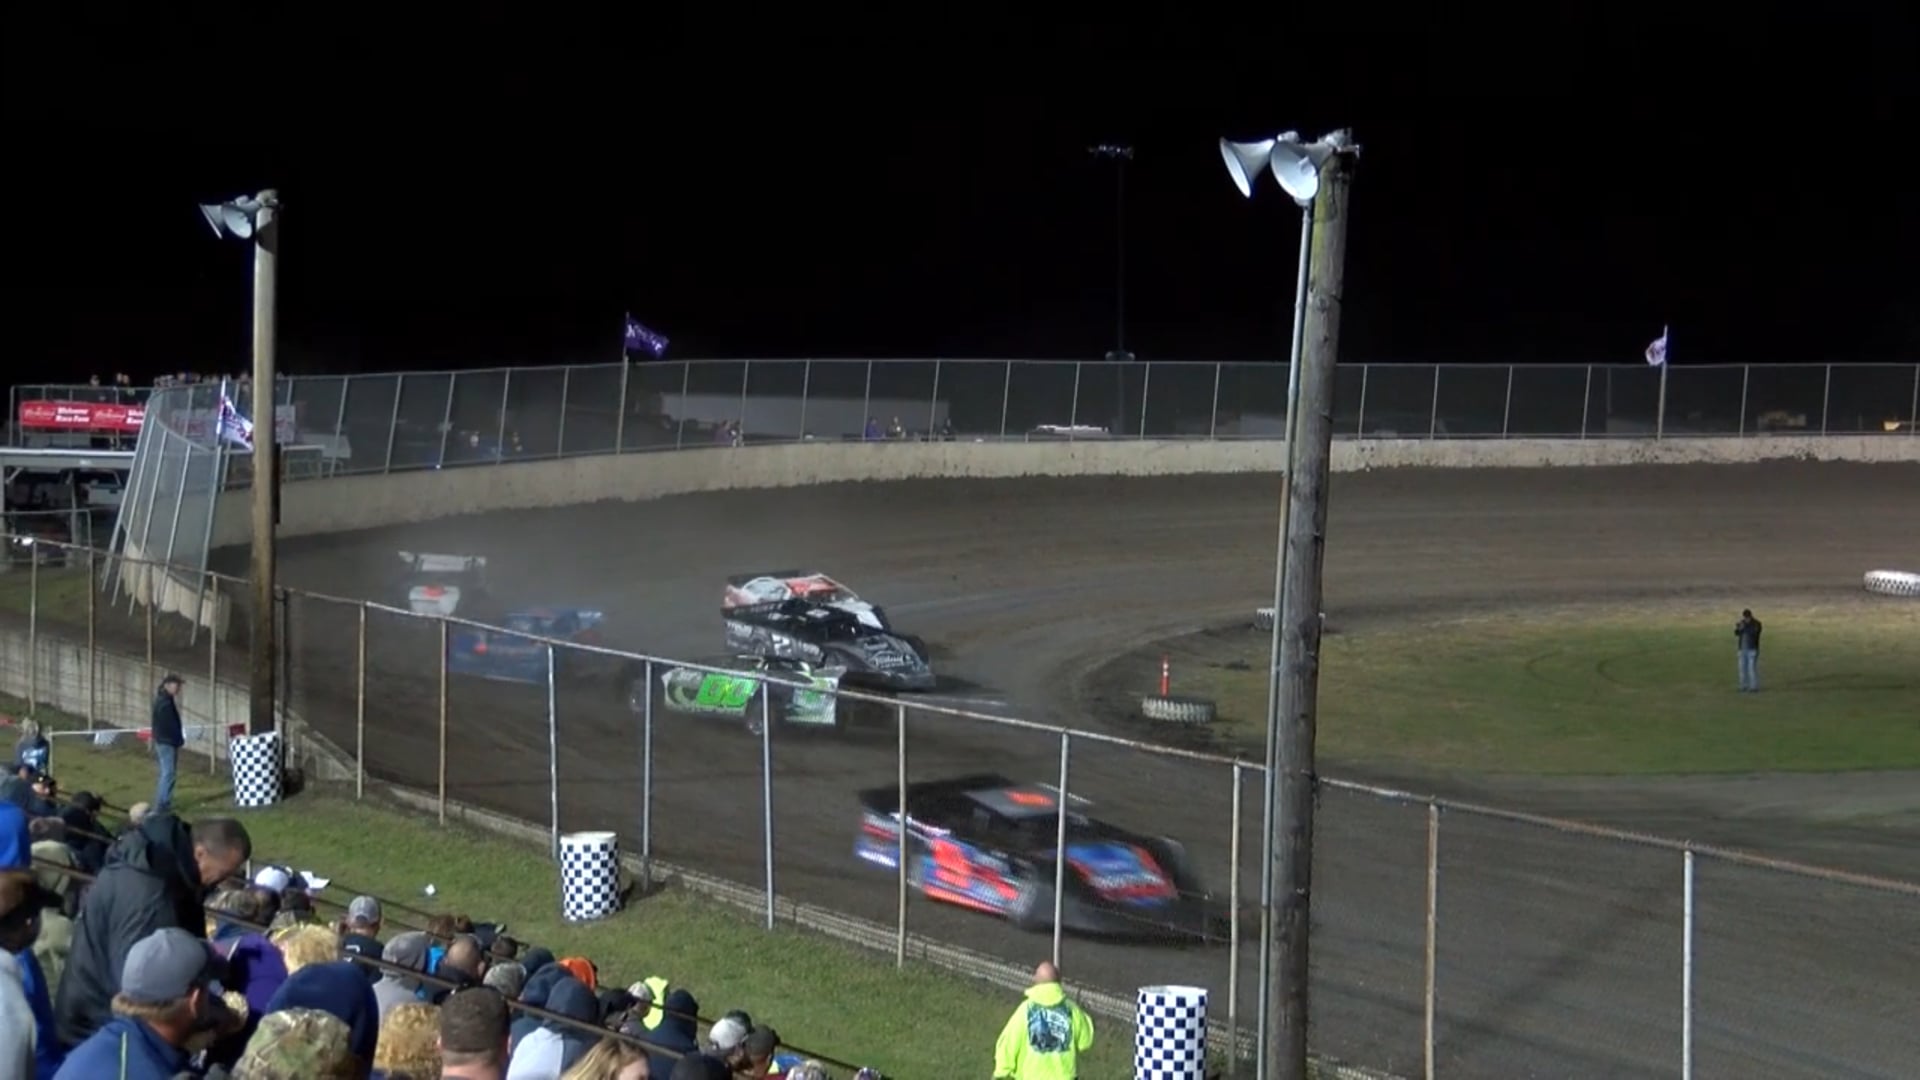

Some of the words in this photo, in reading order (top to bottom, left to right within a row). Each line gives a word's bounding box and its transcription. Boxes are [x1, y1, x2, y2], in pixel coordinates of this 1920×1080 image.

[57, 407, 88, 415] Welcome
[55, 415, 73, 423] Race
[73, 415, 90, 423] Fans
